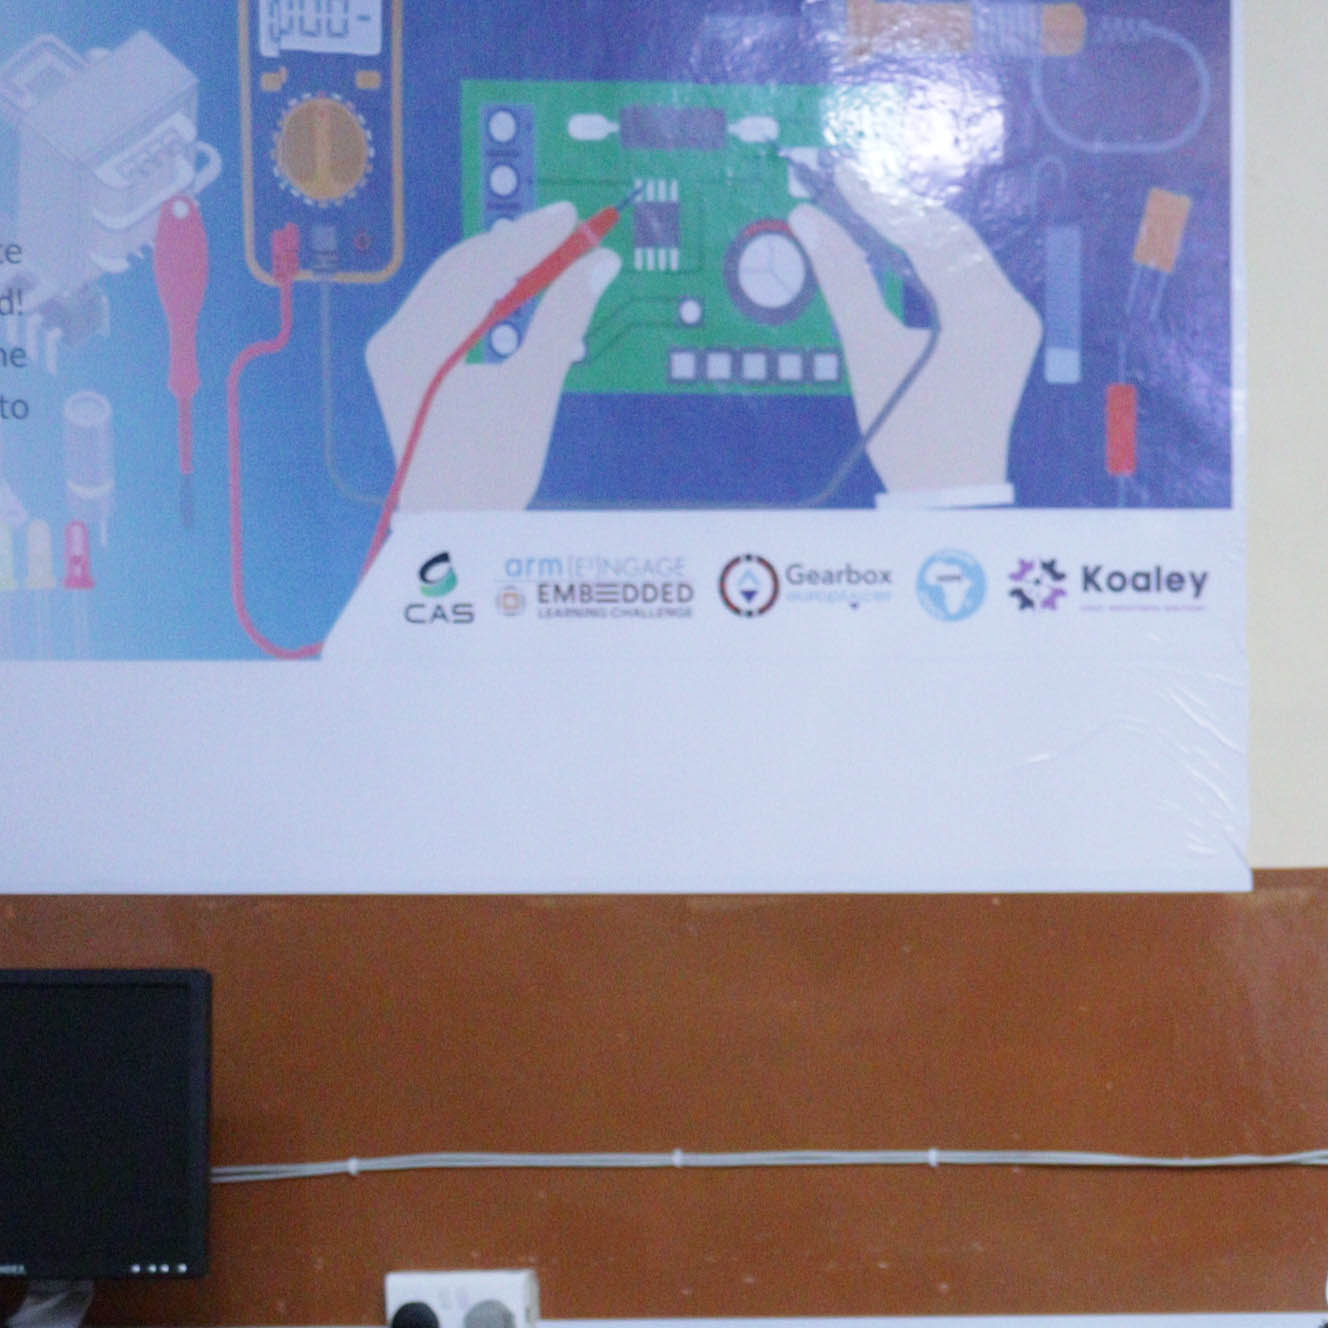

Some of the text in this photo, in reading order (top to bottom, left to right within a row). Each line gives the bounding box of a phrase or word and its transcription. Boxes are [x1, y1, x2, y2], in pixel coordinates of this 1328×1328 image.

[504, 556, 563, 577] arm
[785, 563, 892, 585] Gearbox
[1082, 565, 1209, 598] Koaley
[537, 583, 695, 604] EMBEDDED
[404, 603, 475, 624] CAS
